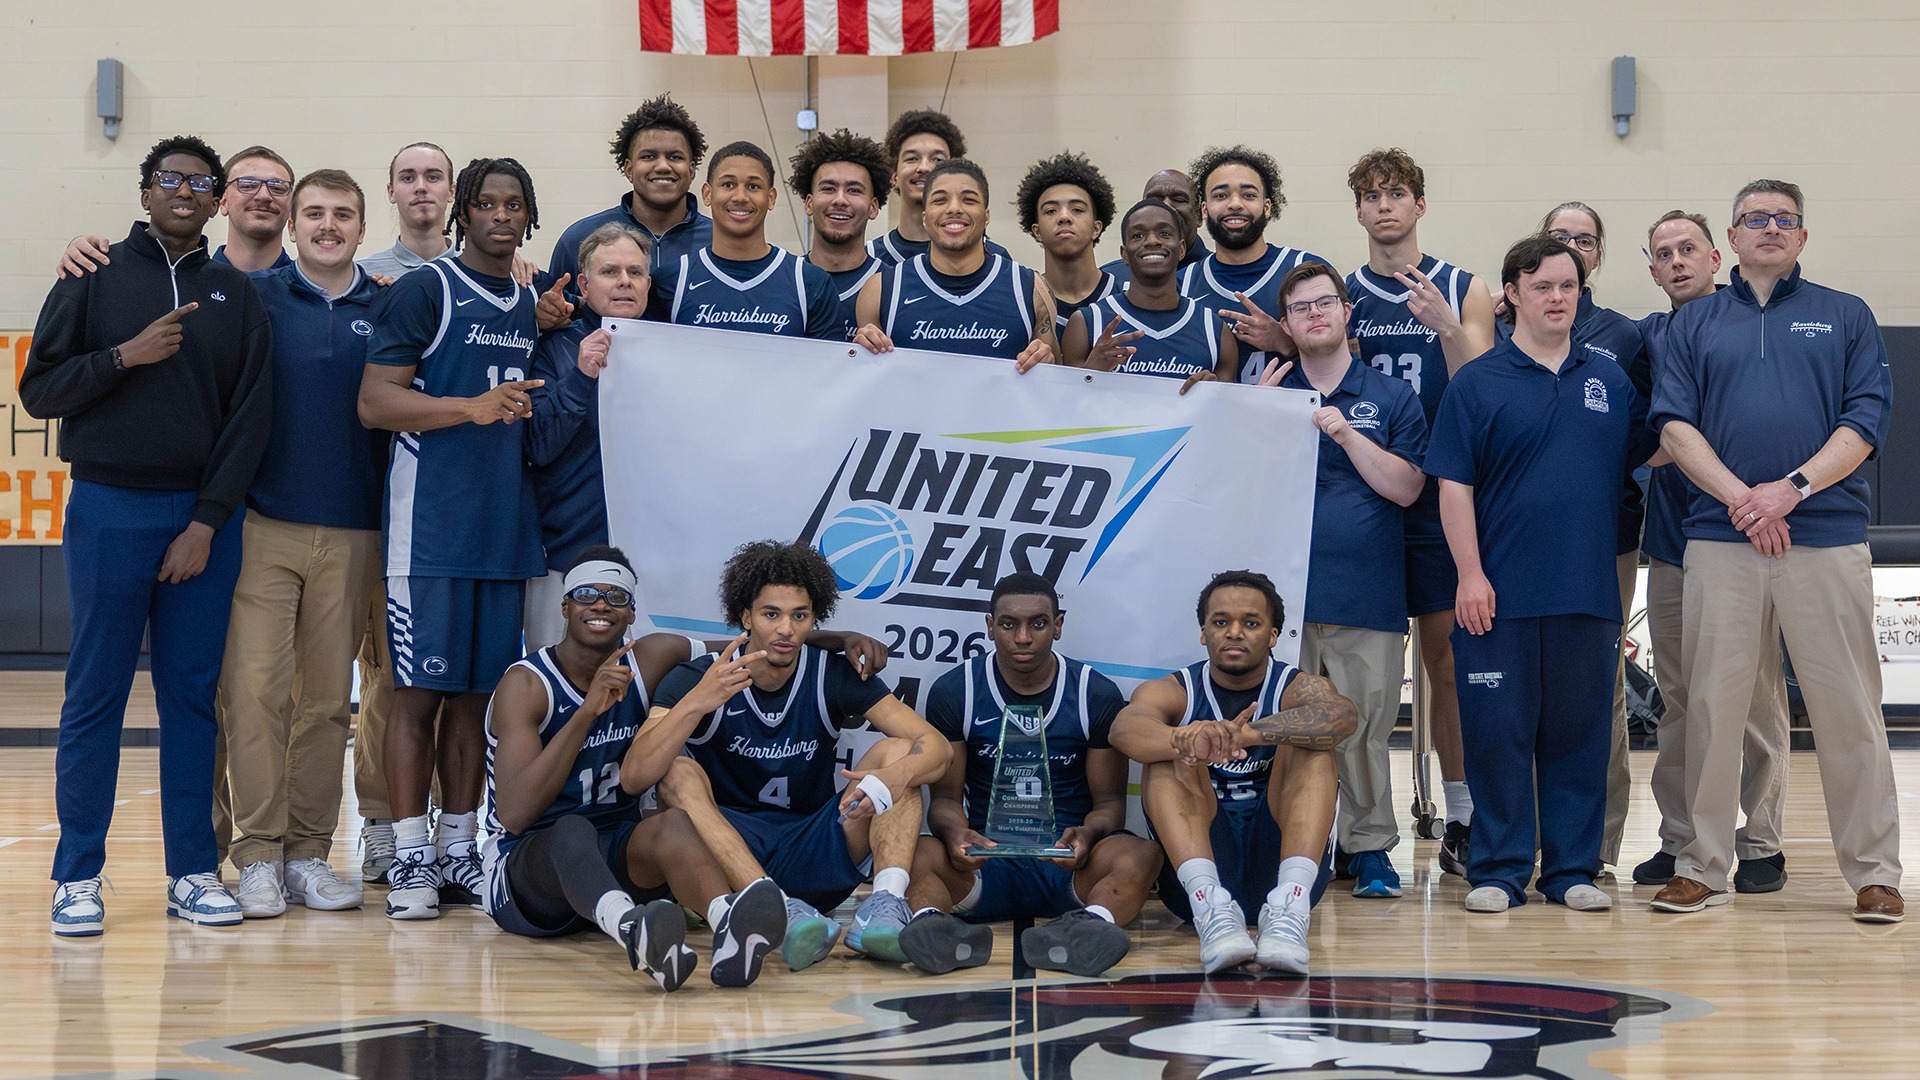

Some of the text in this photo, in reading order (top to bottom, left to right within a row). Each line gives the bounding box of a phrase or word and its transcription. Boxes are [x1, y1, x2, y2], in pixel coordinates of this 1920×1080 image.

[693, 303, 790, 333] Harrisburg
[909, 320, 1009, 348] Harrisburg
[1355, 317, 1438, 344] Harrisburg
[464, 323, 535, 359] Harrisburg
[848, 428, 1112, 530] UNITED
[910, 521, 1088, 591] EAST
[1876, 614, 1899, 627] REEL
[884, 623, 986, 664] 2026
[1879, 629, 1901, 646] EAT
[727, 734, 819, 762] Harrisburg
[579, 761, 620, 805] 12
[758, 776, 791, 810] 4
